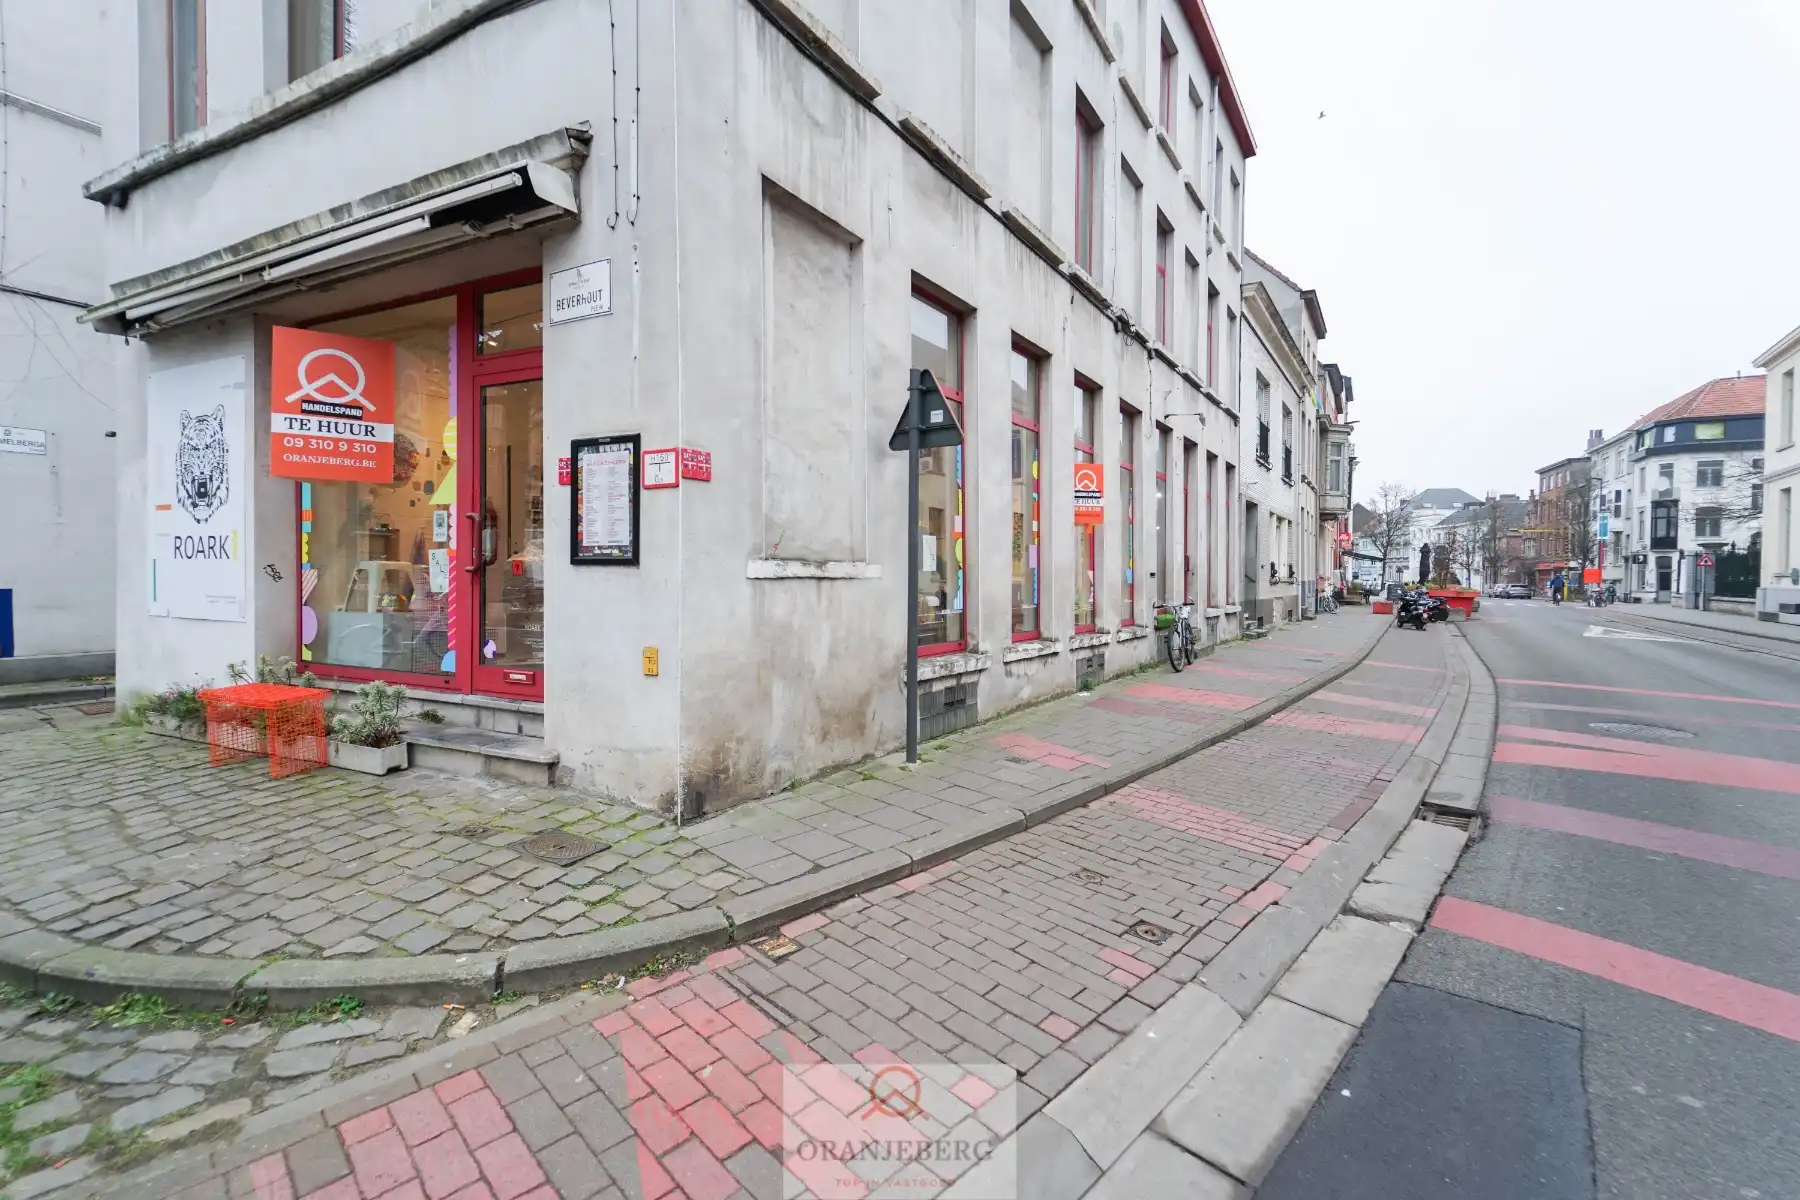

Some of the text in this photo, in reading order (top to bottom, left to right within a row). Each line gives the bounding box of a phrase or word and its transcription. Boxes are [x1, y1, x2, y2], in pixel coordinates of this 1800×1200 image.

[302, 402, 362, 417] HANDELSPAND
[284, 417, 376, 438] TE HUUR
[283, 436, 376, 453] 09 310 9 310
[283, 453, 376, 467] ORANJEBERG.BE
